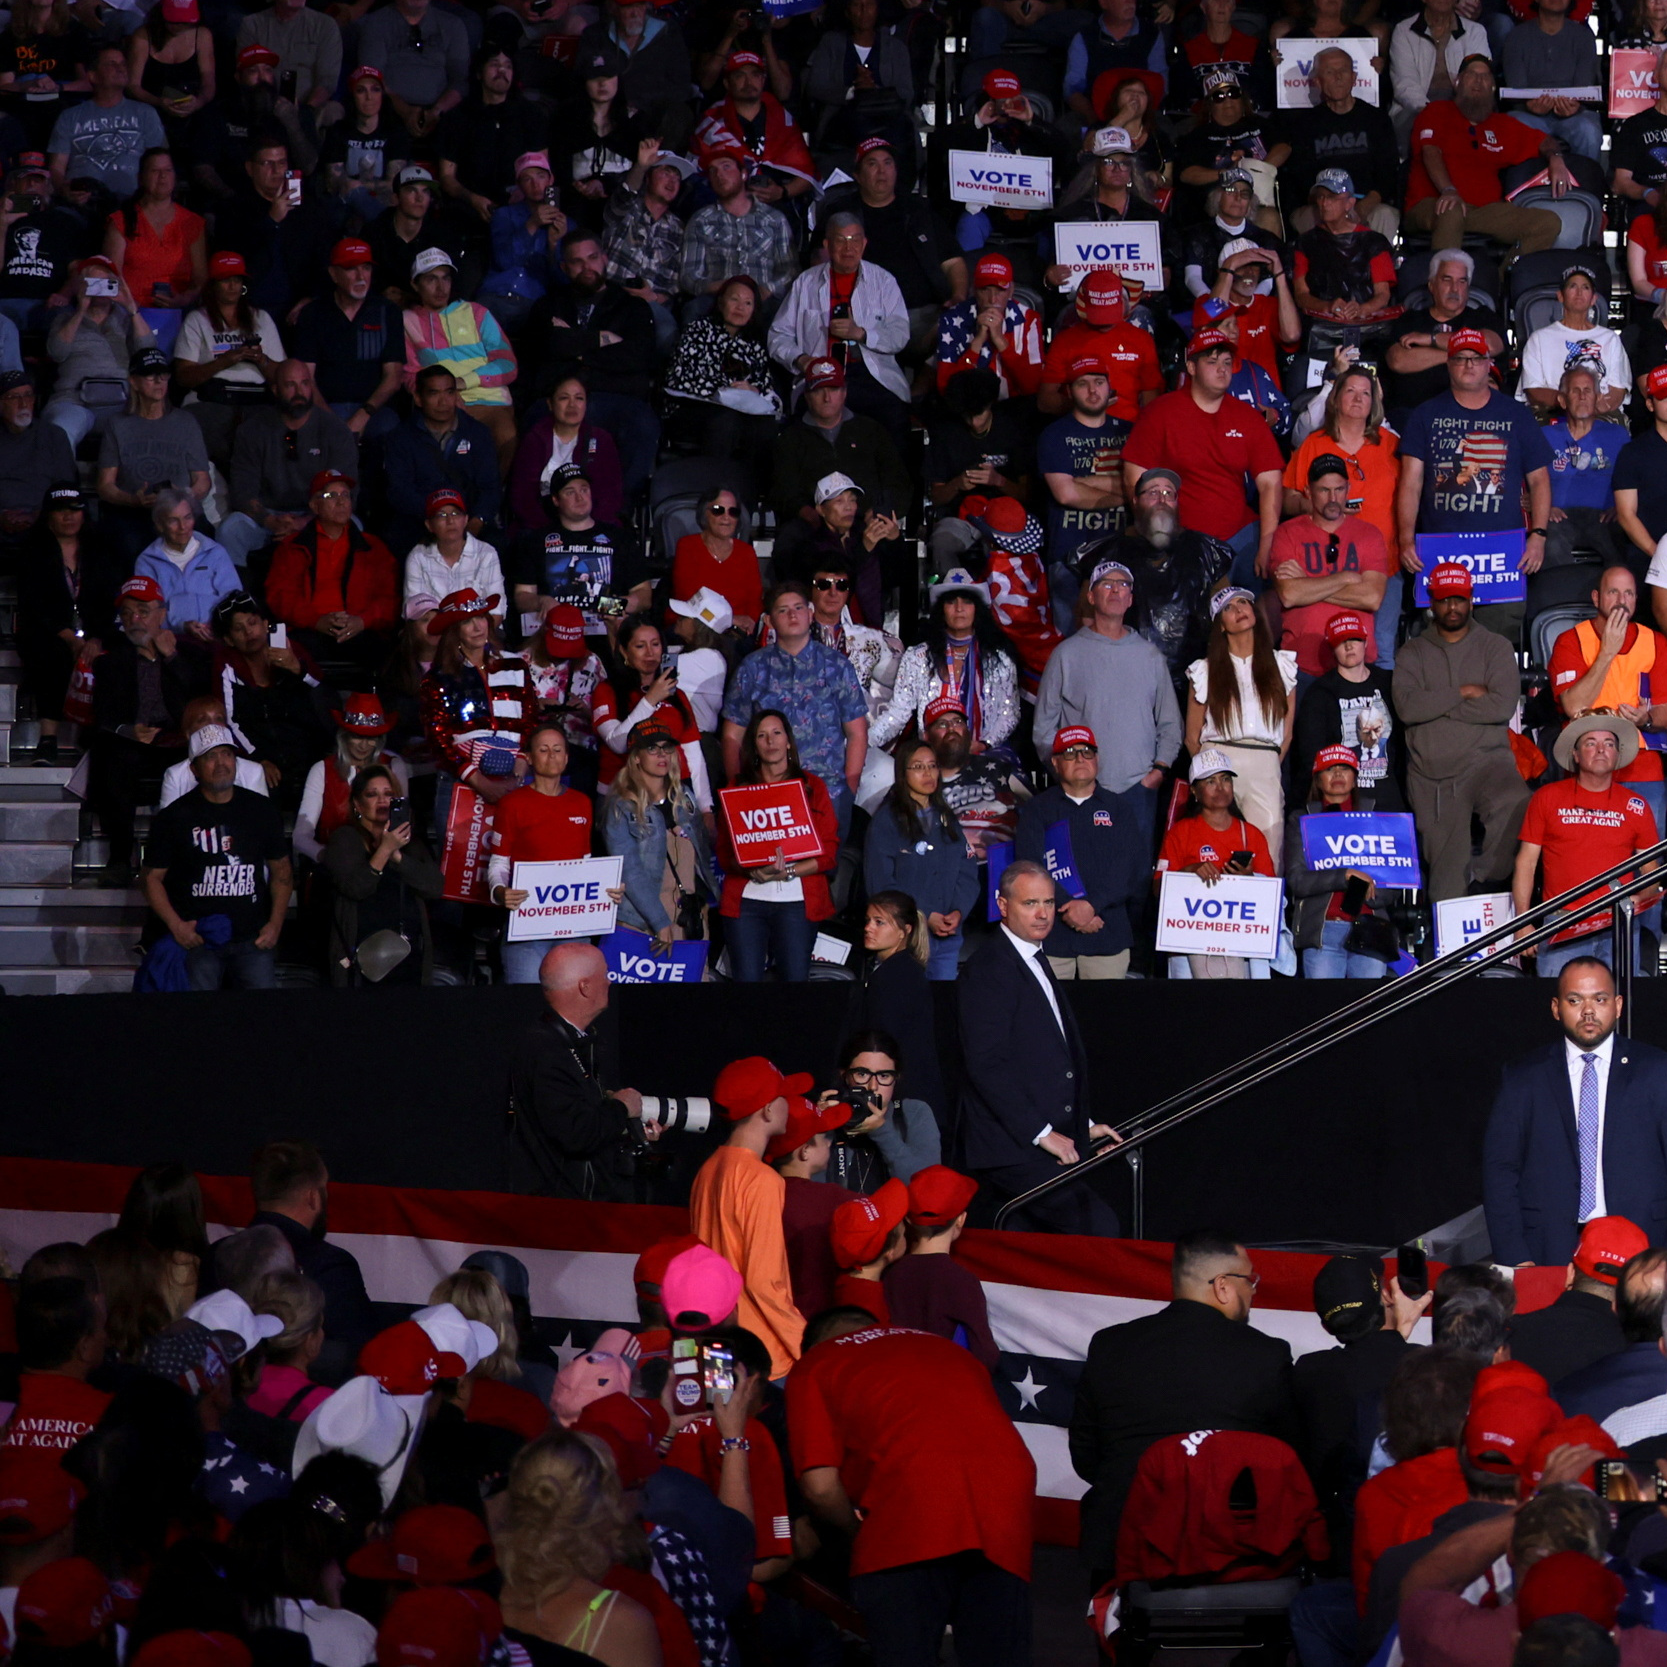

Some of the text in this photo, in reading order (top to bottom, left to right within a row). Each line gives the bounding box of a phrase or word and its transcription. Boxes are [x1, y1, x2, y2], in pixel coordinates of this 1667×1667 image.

[1315, 130, 1369, 150] MAGA
[969, 169, 1033, 187] VOTE
[956, 181, 1047, 199] NOVEMBER 5TH
[1075, 243, 1141, 262] VOTE
[1125, 261, 1155, 273] 5TH
[1432, 417, 1513, 432] FIGHT FIGHT
[51, 490, 80, 499] TRUMP
[1434, 491, 1504, 513] FIGHT
[1496, 571, 1520, 584] 5TH
[740, 804, 795, 828] VOTE
[1557, 807, 1626, 822] MAKE AMERICA
[1562, 816, 1621, 828] GREAT AGAIN
[735, 824, 811, 845] NOVEMBER 5TH
[1324, 833, 1397, 855] VOTE
[1314, 854, 1412, 870] NOVEMBER 5TH
[203, 864, 256, 883] NEVER
[1051, 866, 1072, 882] 5TH
[191, 881, 257, 898] SURRENDER
[535, 881, 600, 904] VOTE
[519, 901, 611, 918] NOVEMBER 5TH
[1184, 897, 1256, 921] VOTE
[1166, 917, 1270, 935] NOVEMBER 5TH
[619, 952, 686, 981] VOTE
[837, 1147, 846, 1178] SONY
[15, 1418, 96, 1437] AMERICA
